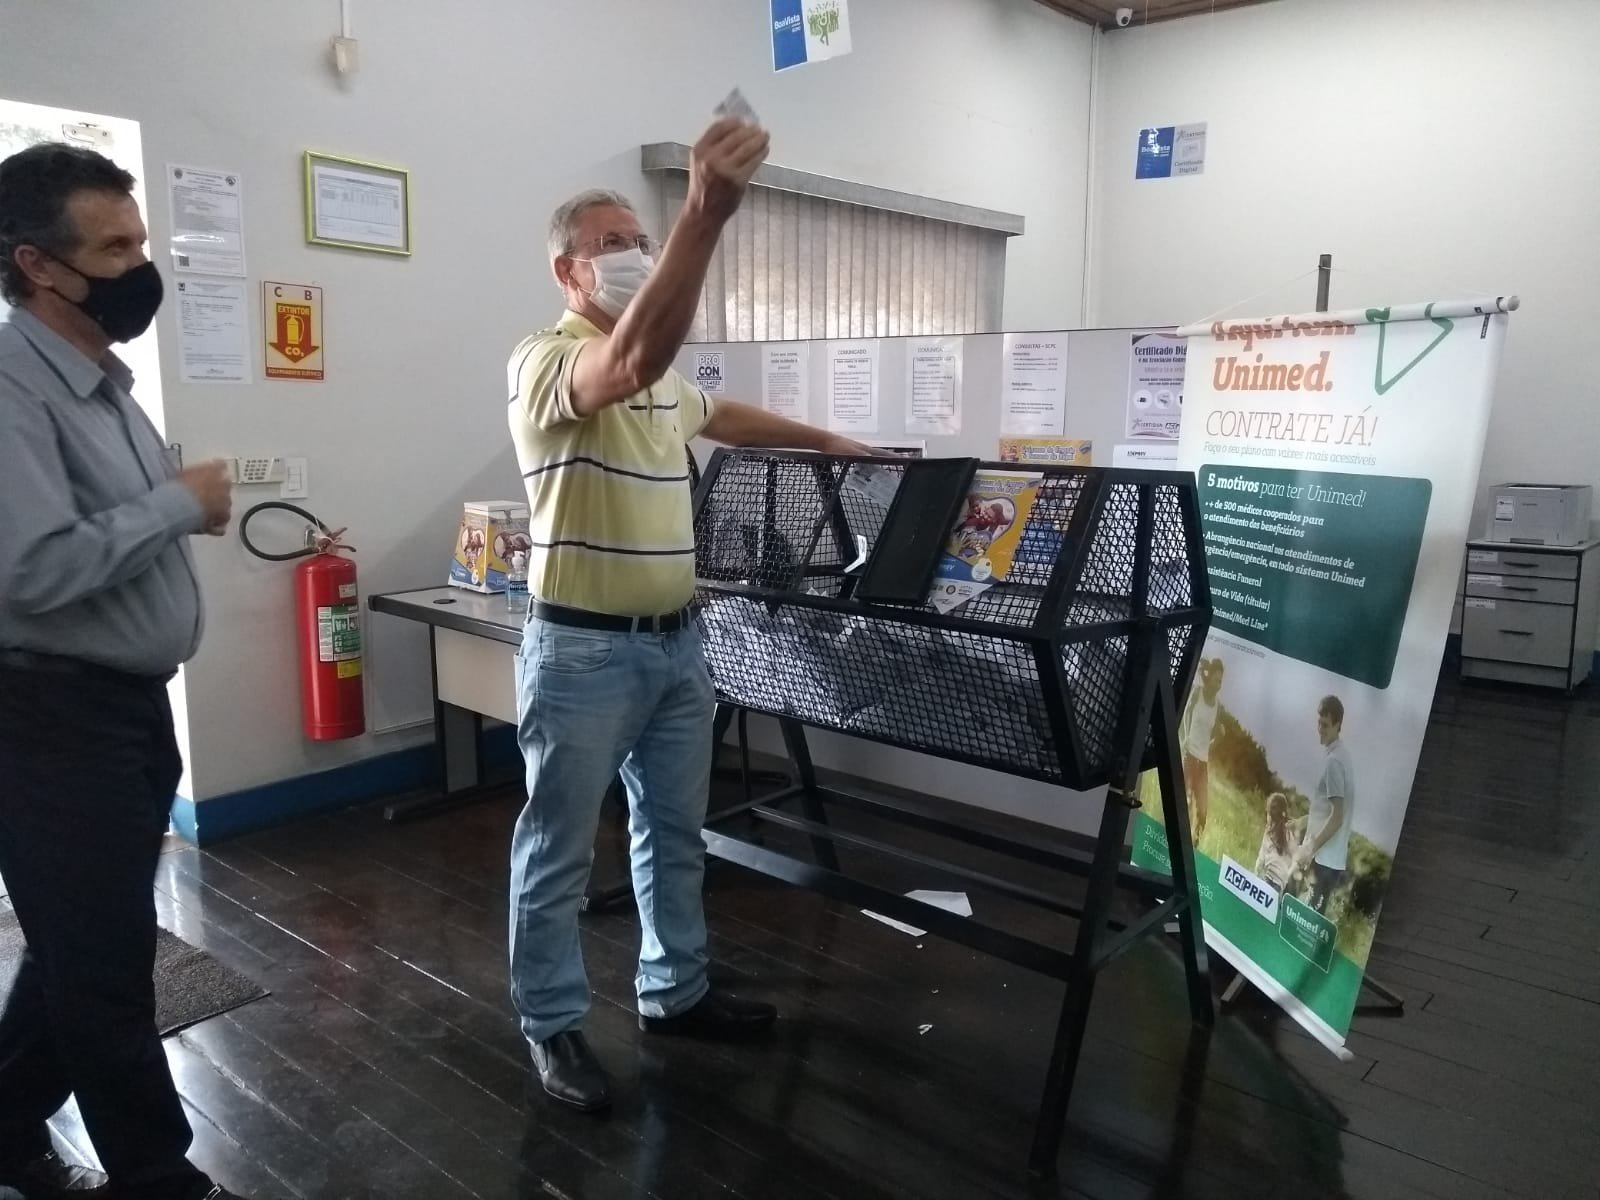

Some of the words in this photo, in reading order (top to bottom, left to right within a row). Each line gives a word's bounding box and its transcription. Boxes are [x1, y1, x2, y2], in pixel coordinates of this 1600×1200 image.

[274, 286, 282, 297] C
[304, 290, 312, 301] B
[278, 306, 310, 315] EXTINTOR
[698, 354, 720, 366] PRO
[1135, 346, 1174, 356] Certificado
[698, 366, 720, 377] CON
[1213, 351, 1333, 391] Unimed.
[1206, 410, 1333, 443] CONTRATE
[1335, 405, 1378, 446] JÁ!
[1229, 445, 1240, 454] seu
[1241, 445, 1261, 457] plano
[1262, 448, 1276, 457] com
[1278, 448, 1303, 460] valores
[1305, 451, 1328, 462] mais
[1208, 473, 1215, 487] 5
[1216, 475, 1260, 493] motivos
[1259, 482, 1285, 499] para
[1286, 483, 1304, 500] ter
[1307, 484, 1367, 508] Unimed!
[1214, 500, 1223, 510] de
[1224, 501, 1237, 512] 500
[1237, 503, 1263, 516] médicos
[1263, 508, 1301, 522] cooperados
[1302, 515, 1324, 527] para
[1209, 514, 1249, 528] atendimento
[1249, 518, 1260, 529] dos
[1261, 520, 1305, 538] beneficiários
[1205, 531, 1246, 546] Abrangência
[1246, 538, 1275, 553] nacional
[1285, 548, 1342, 567] atendimentos
[1344, 558, 1355, 570] de
[1205, 545, 1268, 567] rgência/emergência,
[1278, 560, 1295, 573] todo
[1296, 565, 1330, 581] sistema
[1331, 570, 1366, 588] Unimed
[1237, 572, 1263, 587] Funeral
[1222, 588, 1230, 599] de
[1230, 590, 1244, 604] Vida
[1244, 593, 1271, 613] (titular)
[1224, 865, 1274, 909] ACIPREV
[1286, 905, 1319, 935] Unimed
